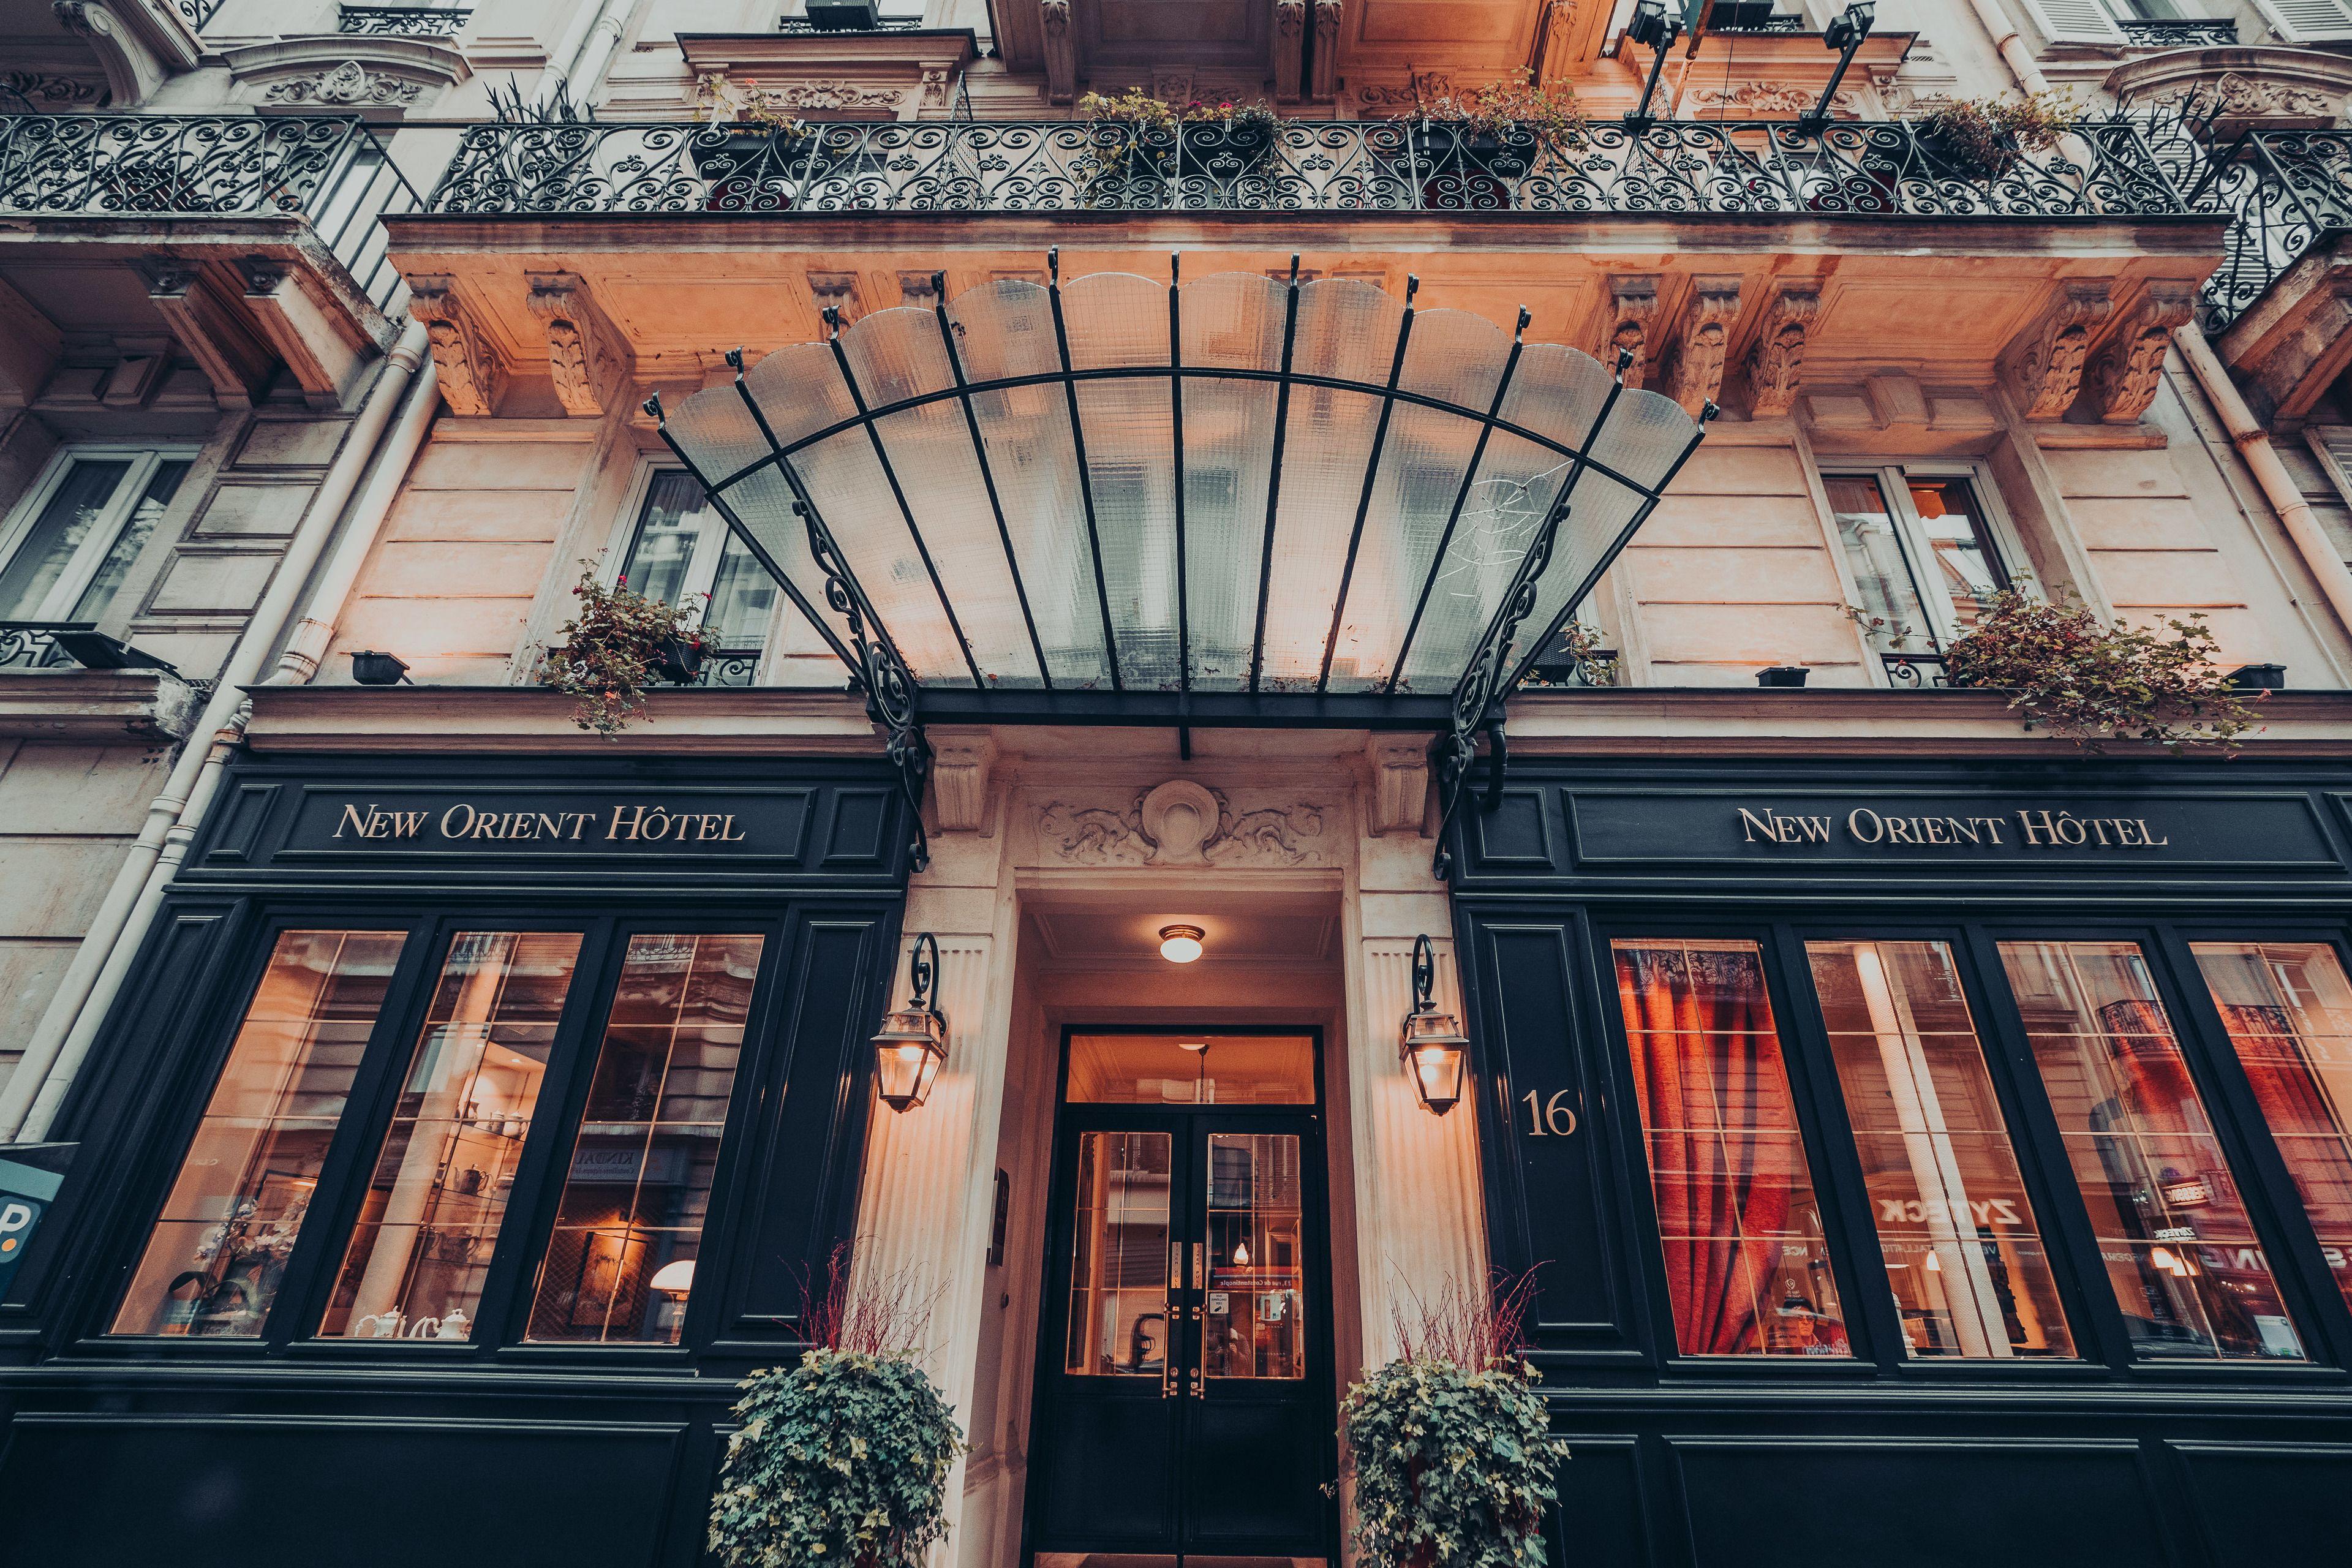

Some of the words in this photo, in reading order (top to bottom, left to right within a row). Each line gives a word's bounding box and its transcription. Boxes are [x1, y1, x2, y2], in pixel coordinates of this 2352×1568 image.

[332, 804, 429, 838] NEW
[440, 804, 595, 840] ORIENT
[605, 805, 746, 841] HÔTEL
[1737, 807, 1831, 843] NEW
[1847, 807, 2005, 844] ORIENT
[2016, 810, 2168, 846] HÔTEL
[1522, 1089, 1576, 1136] 16
[0, 1203, 31, 1235] P
